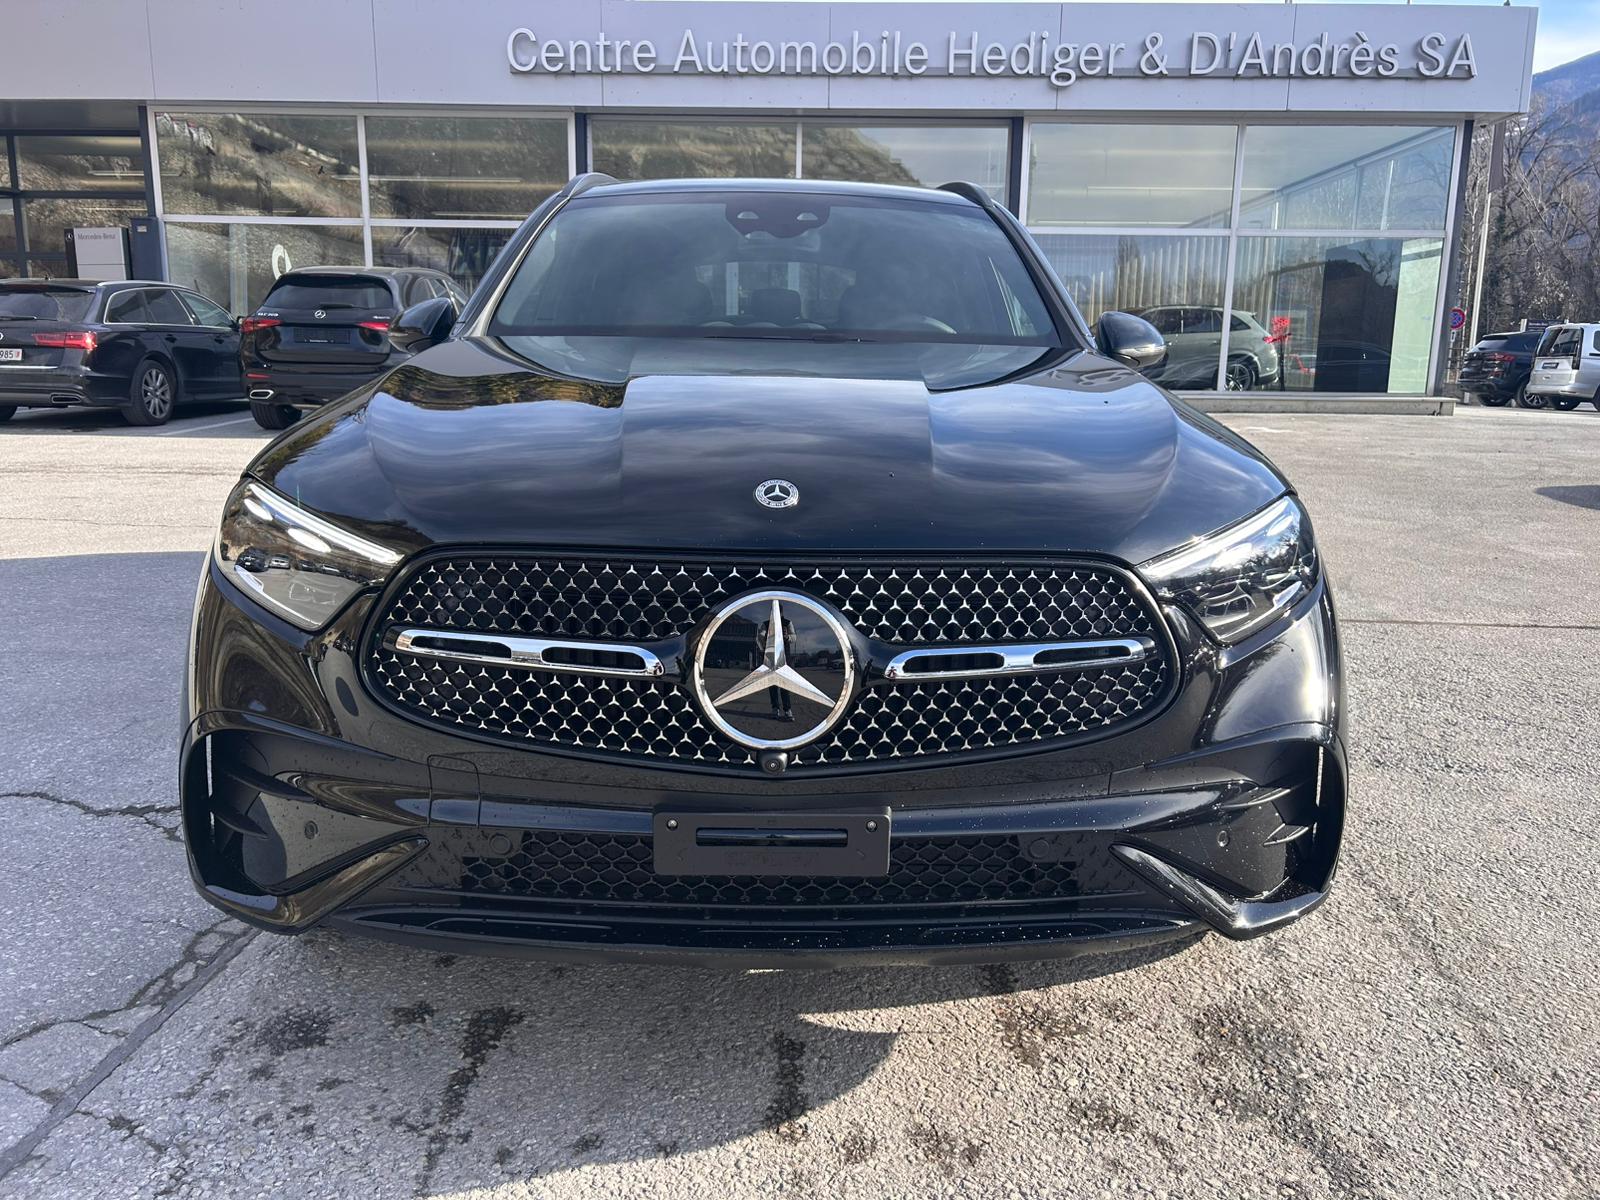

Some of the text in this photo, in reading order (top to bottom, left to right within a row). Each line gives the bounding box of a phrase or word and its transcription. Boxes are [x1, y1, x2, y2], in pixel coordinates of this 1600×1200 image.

[507, 27, 1478, 87] Centre Automobile Hediger & D'Andrès SA
